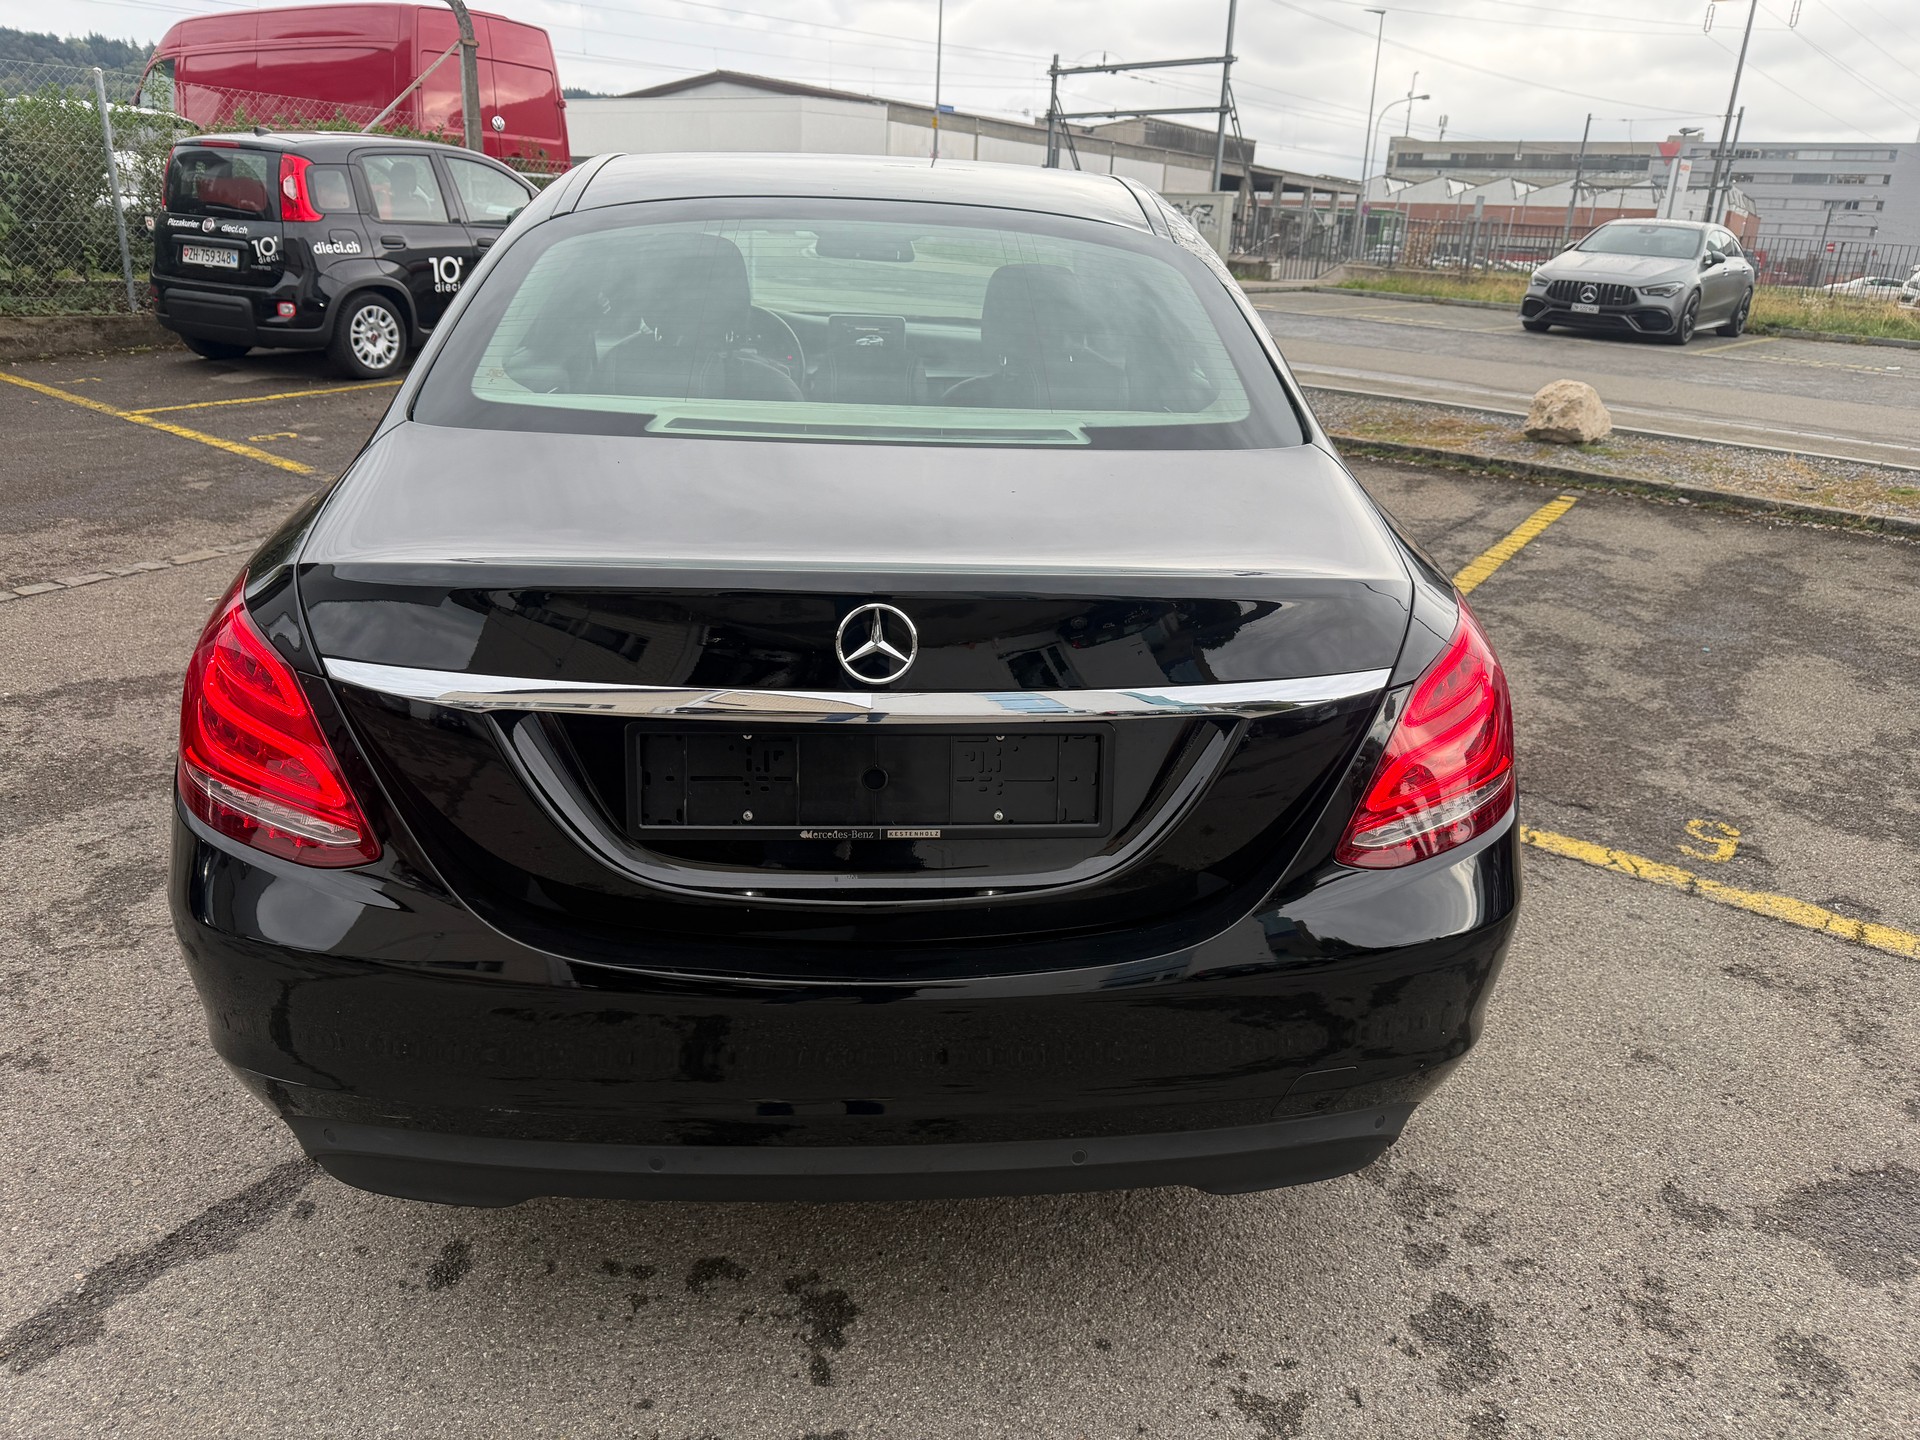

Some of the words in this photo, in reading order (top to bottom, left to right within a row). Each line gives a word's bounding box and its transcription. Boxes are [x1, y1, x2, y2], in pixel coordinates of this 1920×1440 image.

[167, 217, 200, 228] Pizzakurier
[221, 224, 248, 234] dieci.ch
[313, 241, 361, 254] dieci.ch
[258, 253, 280, 264] dieci
[434, 281, 461, 293] dieci
[800, 829, 874, 839] Mercedes-Benz
[888, 830, 940, 838] KESTENHOLZ
